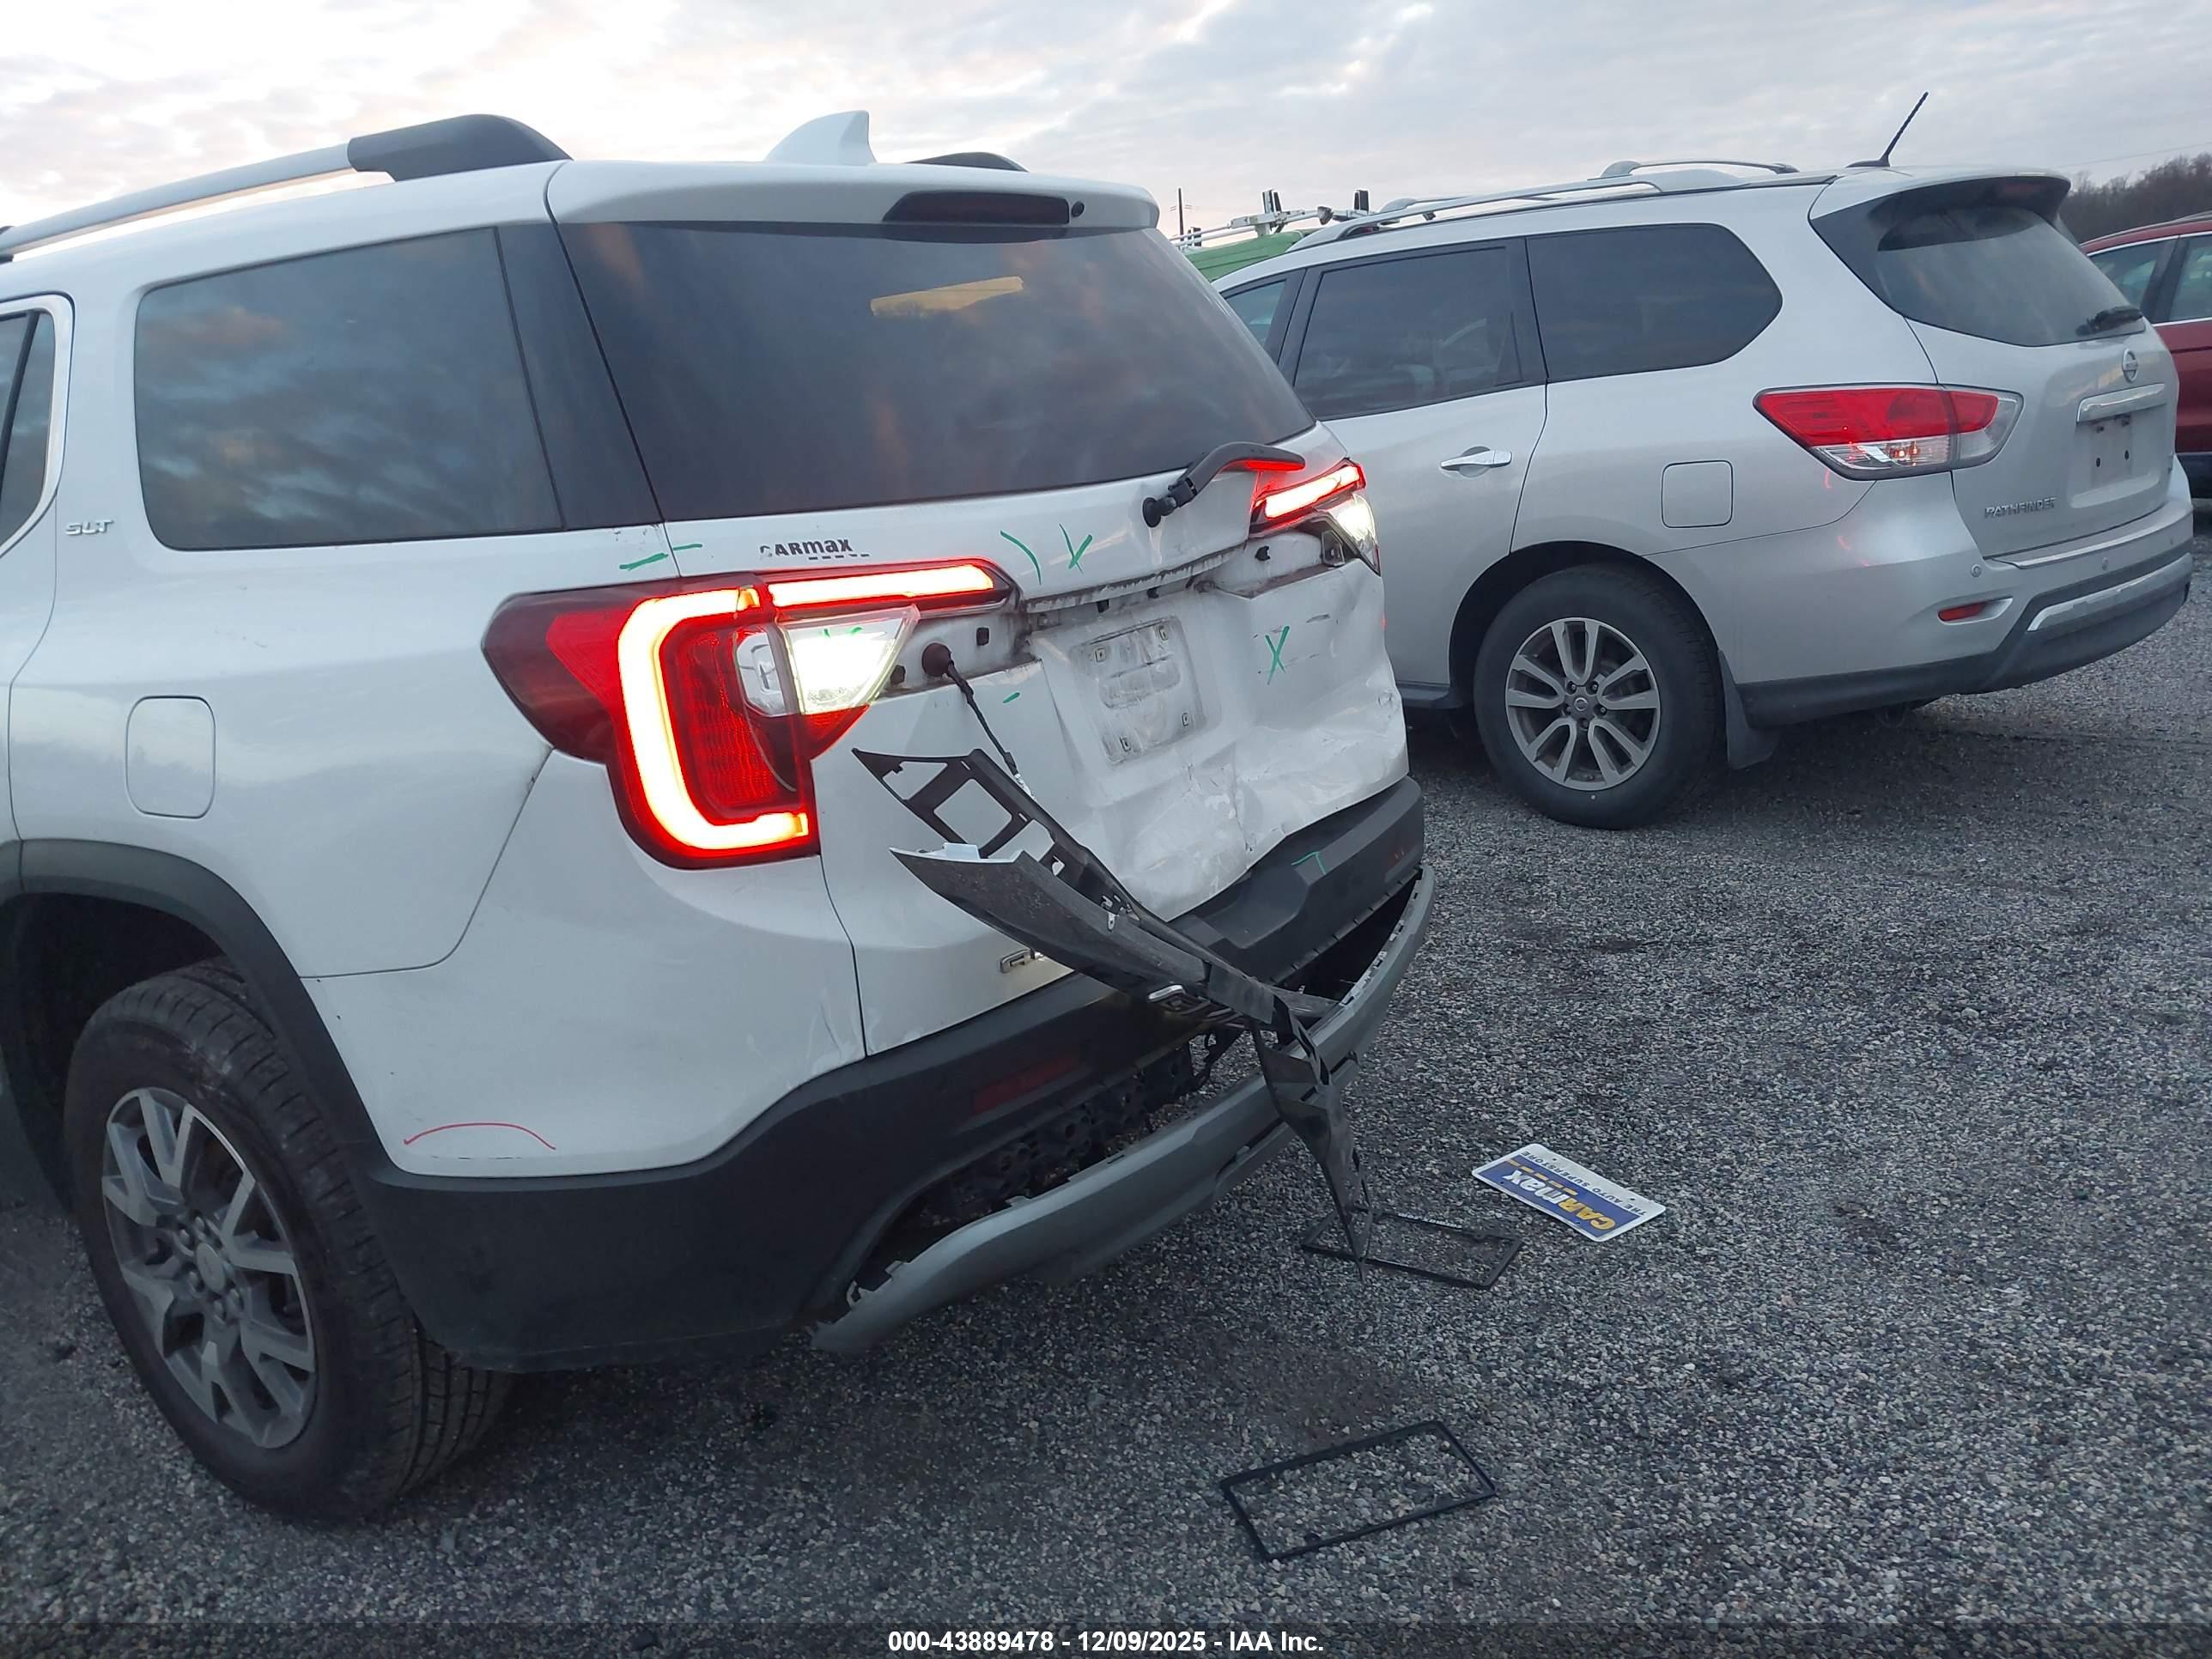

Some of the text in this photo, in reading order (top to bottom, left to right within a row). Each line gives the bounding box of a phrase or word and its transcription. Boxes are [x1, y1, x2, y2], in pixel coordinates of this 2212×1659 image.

[1984, 497, 2057, 518] PATHFINDER
[65, 520, 114, 536] SLT
[1521, 1150, 1647, 1215] THE AUTO SUPERSTORE
